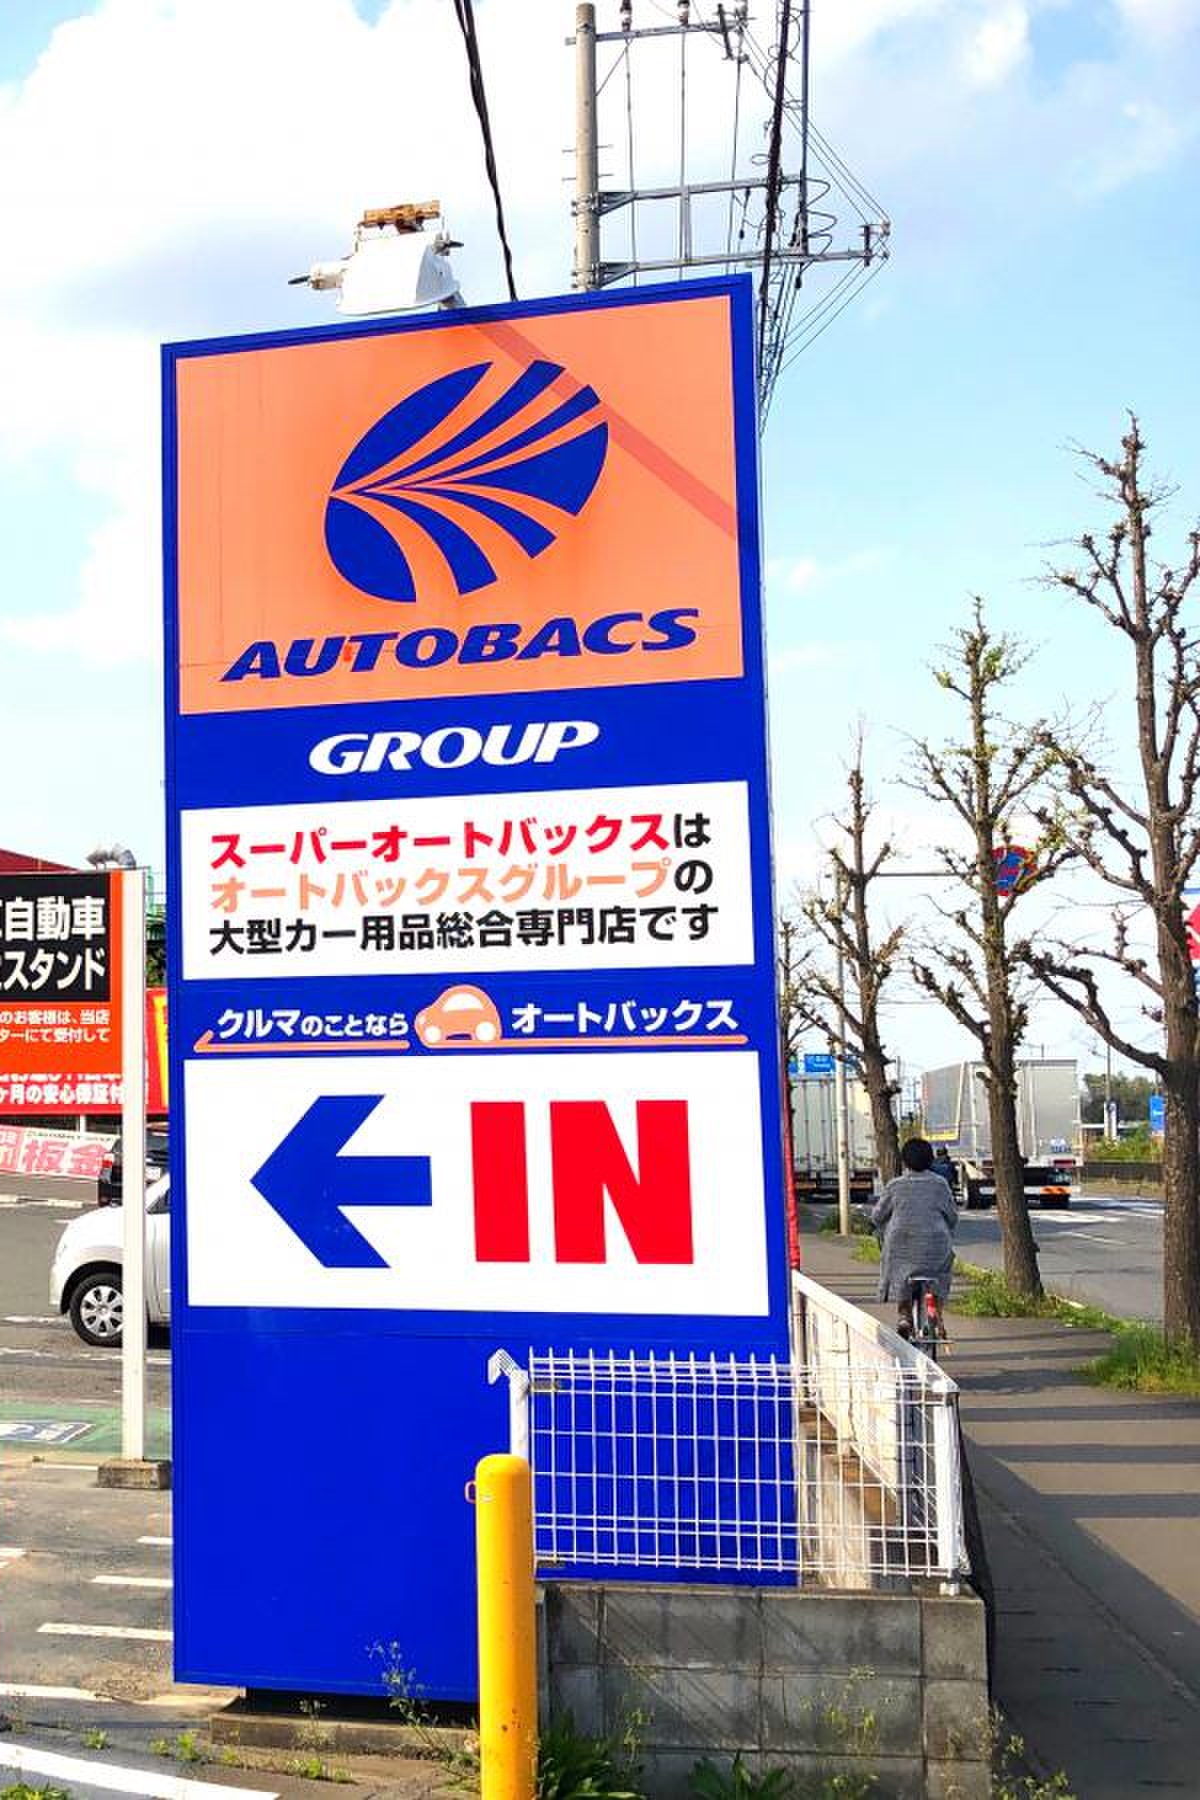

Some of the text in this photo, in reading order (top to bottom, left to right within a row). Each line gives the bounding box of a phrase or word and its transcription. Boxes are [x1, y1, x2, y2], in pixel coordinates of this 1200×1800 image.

[220, 608, 699, 682] AUTOBACS
[308, 720, 600, 776] GROUP
[209, 811, 711, 869] スーパーオートバックスは
[210, 856, 714, 915] オートバックスグループの
[208, 901, 719, 957] 大型カー用品総合専門店です
[216, 999, 739, 1040] クルマのことなら オートバックス
[470, 1100, 694, 1265] IN
